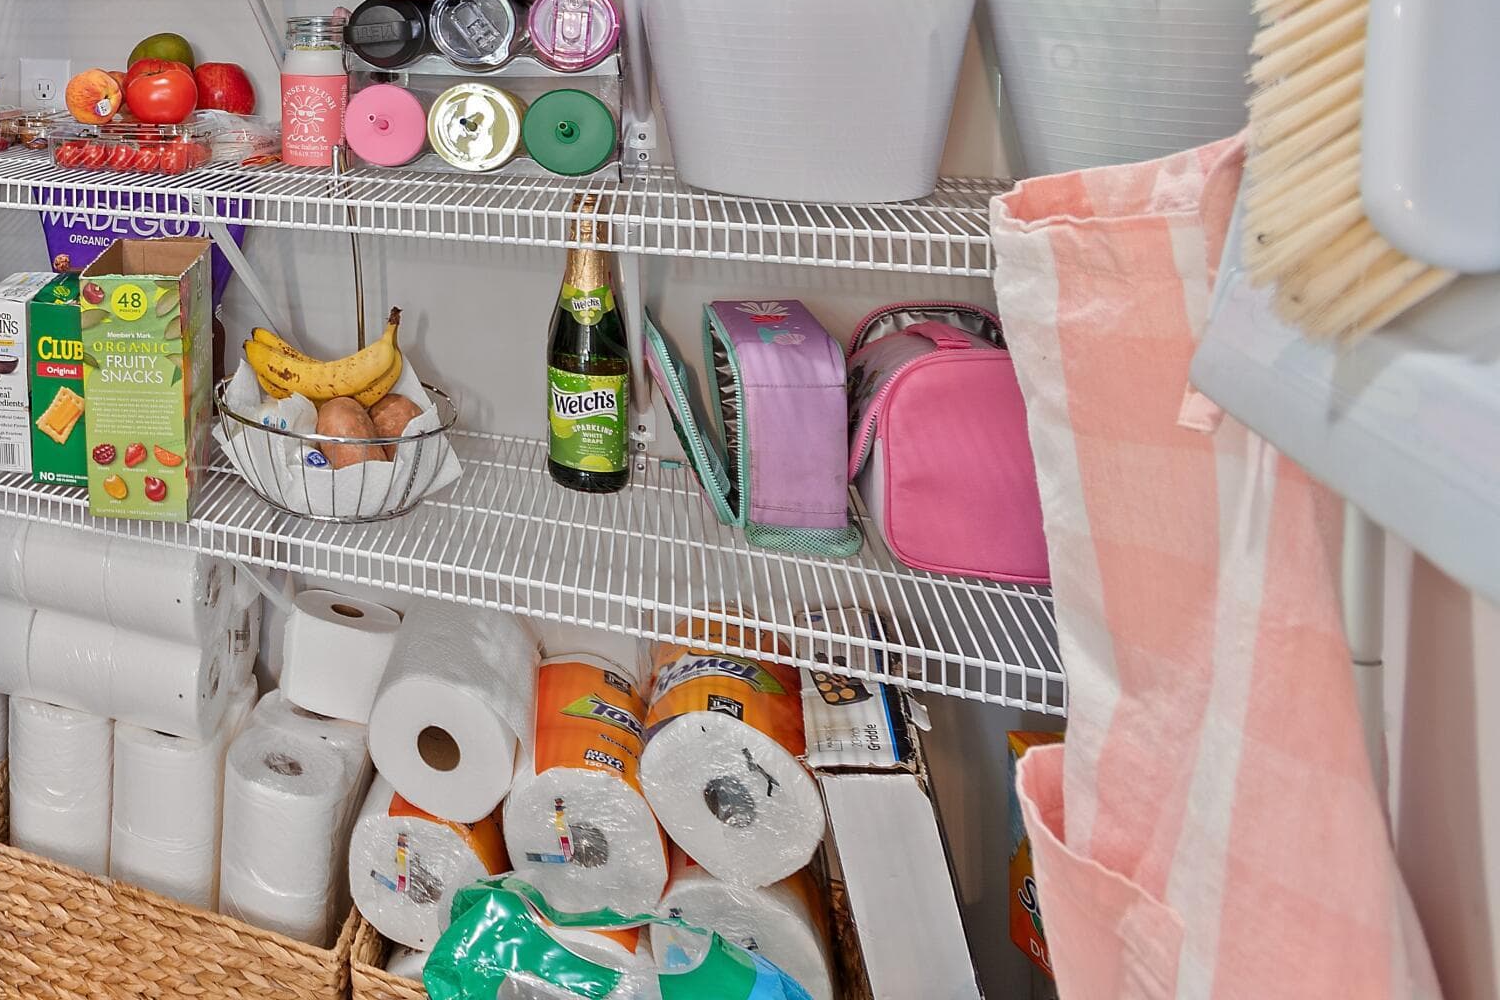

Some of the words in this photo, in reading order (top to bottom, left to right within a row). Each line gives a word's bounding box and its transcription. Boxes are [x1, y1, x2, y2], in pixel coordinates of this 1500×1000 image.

[354, 22, 397, 42] YETI
[308, 86, 336, 110] SLUSH
[118, 292, 142, 309] 48
[573, 298, 600, 310] Welch's
[37, 336, 83, 360] CLUB
[93, 341, 170, 353] ORGANIC
[106, 355, 158, 369] FRUITY
[46, 366, 77, 377] Original
[101, 370, 164, 384] SNACKS
[554, 390, 615, 415] Welch's
[39, 472, 55, 481] NO
[863, 724, 881, 751] Griddle
